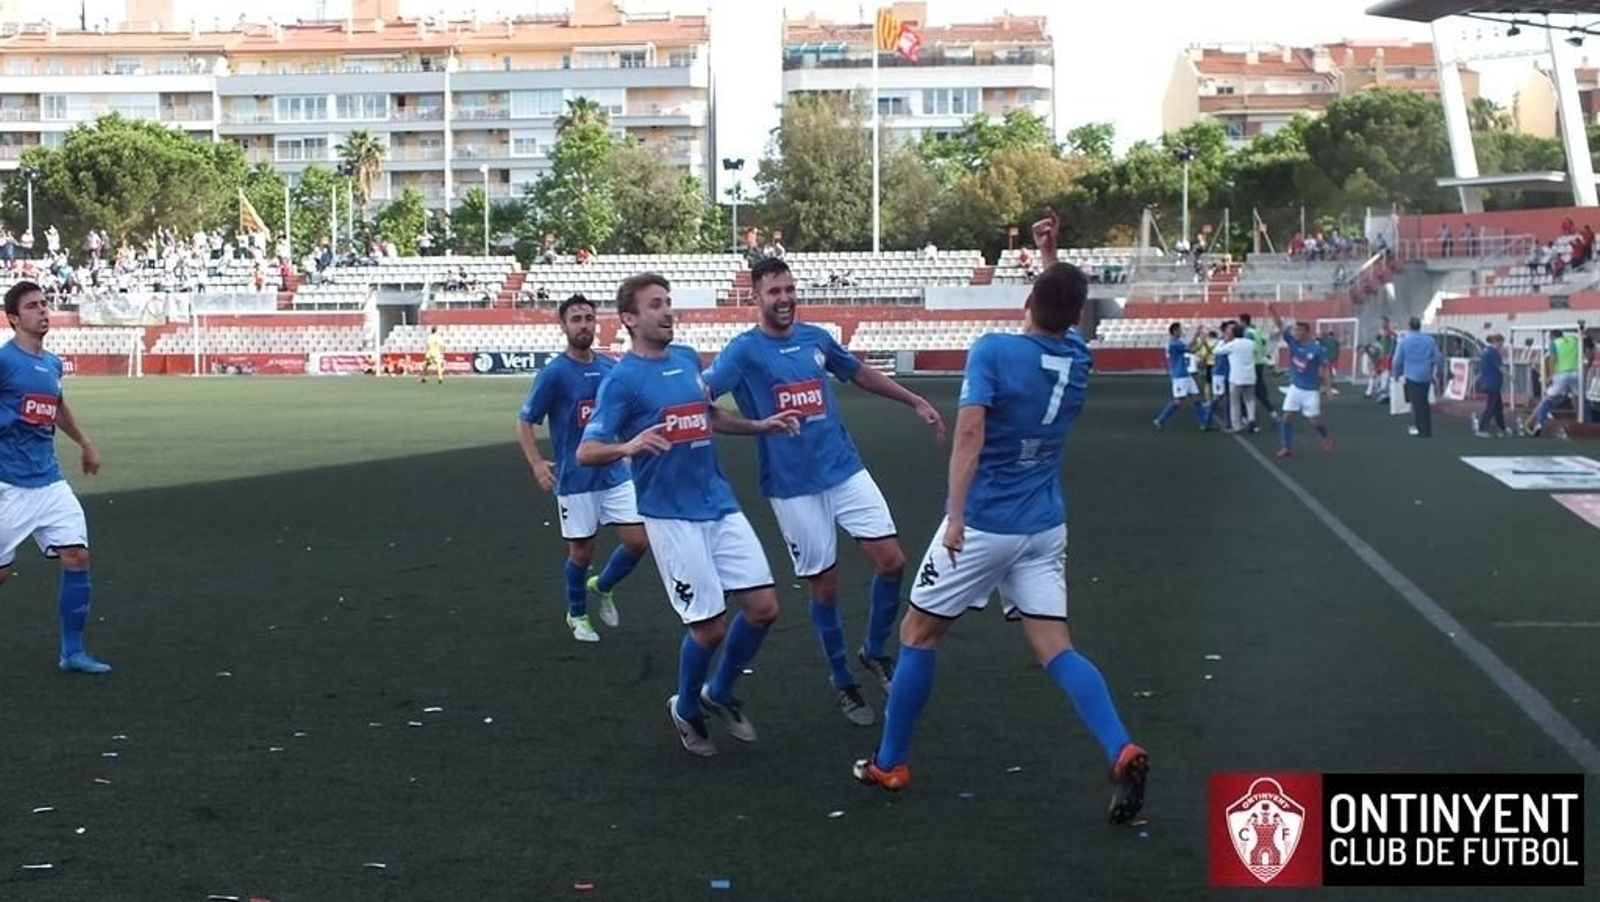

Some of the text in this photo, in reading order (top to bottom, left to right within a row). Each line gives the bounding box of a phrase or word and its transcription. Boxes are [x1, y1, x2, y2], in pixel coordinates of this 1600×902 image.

[501, 353, 535, 368] Veri
[779, 389, 823, 409] Pinay
[1041, 354, 1074, 425] 7
[665, 414, 707, 432] Pinay
